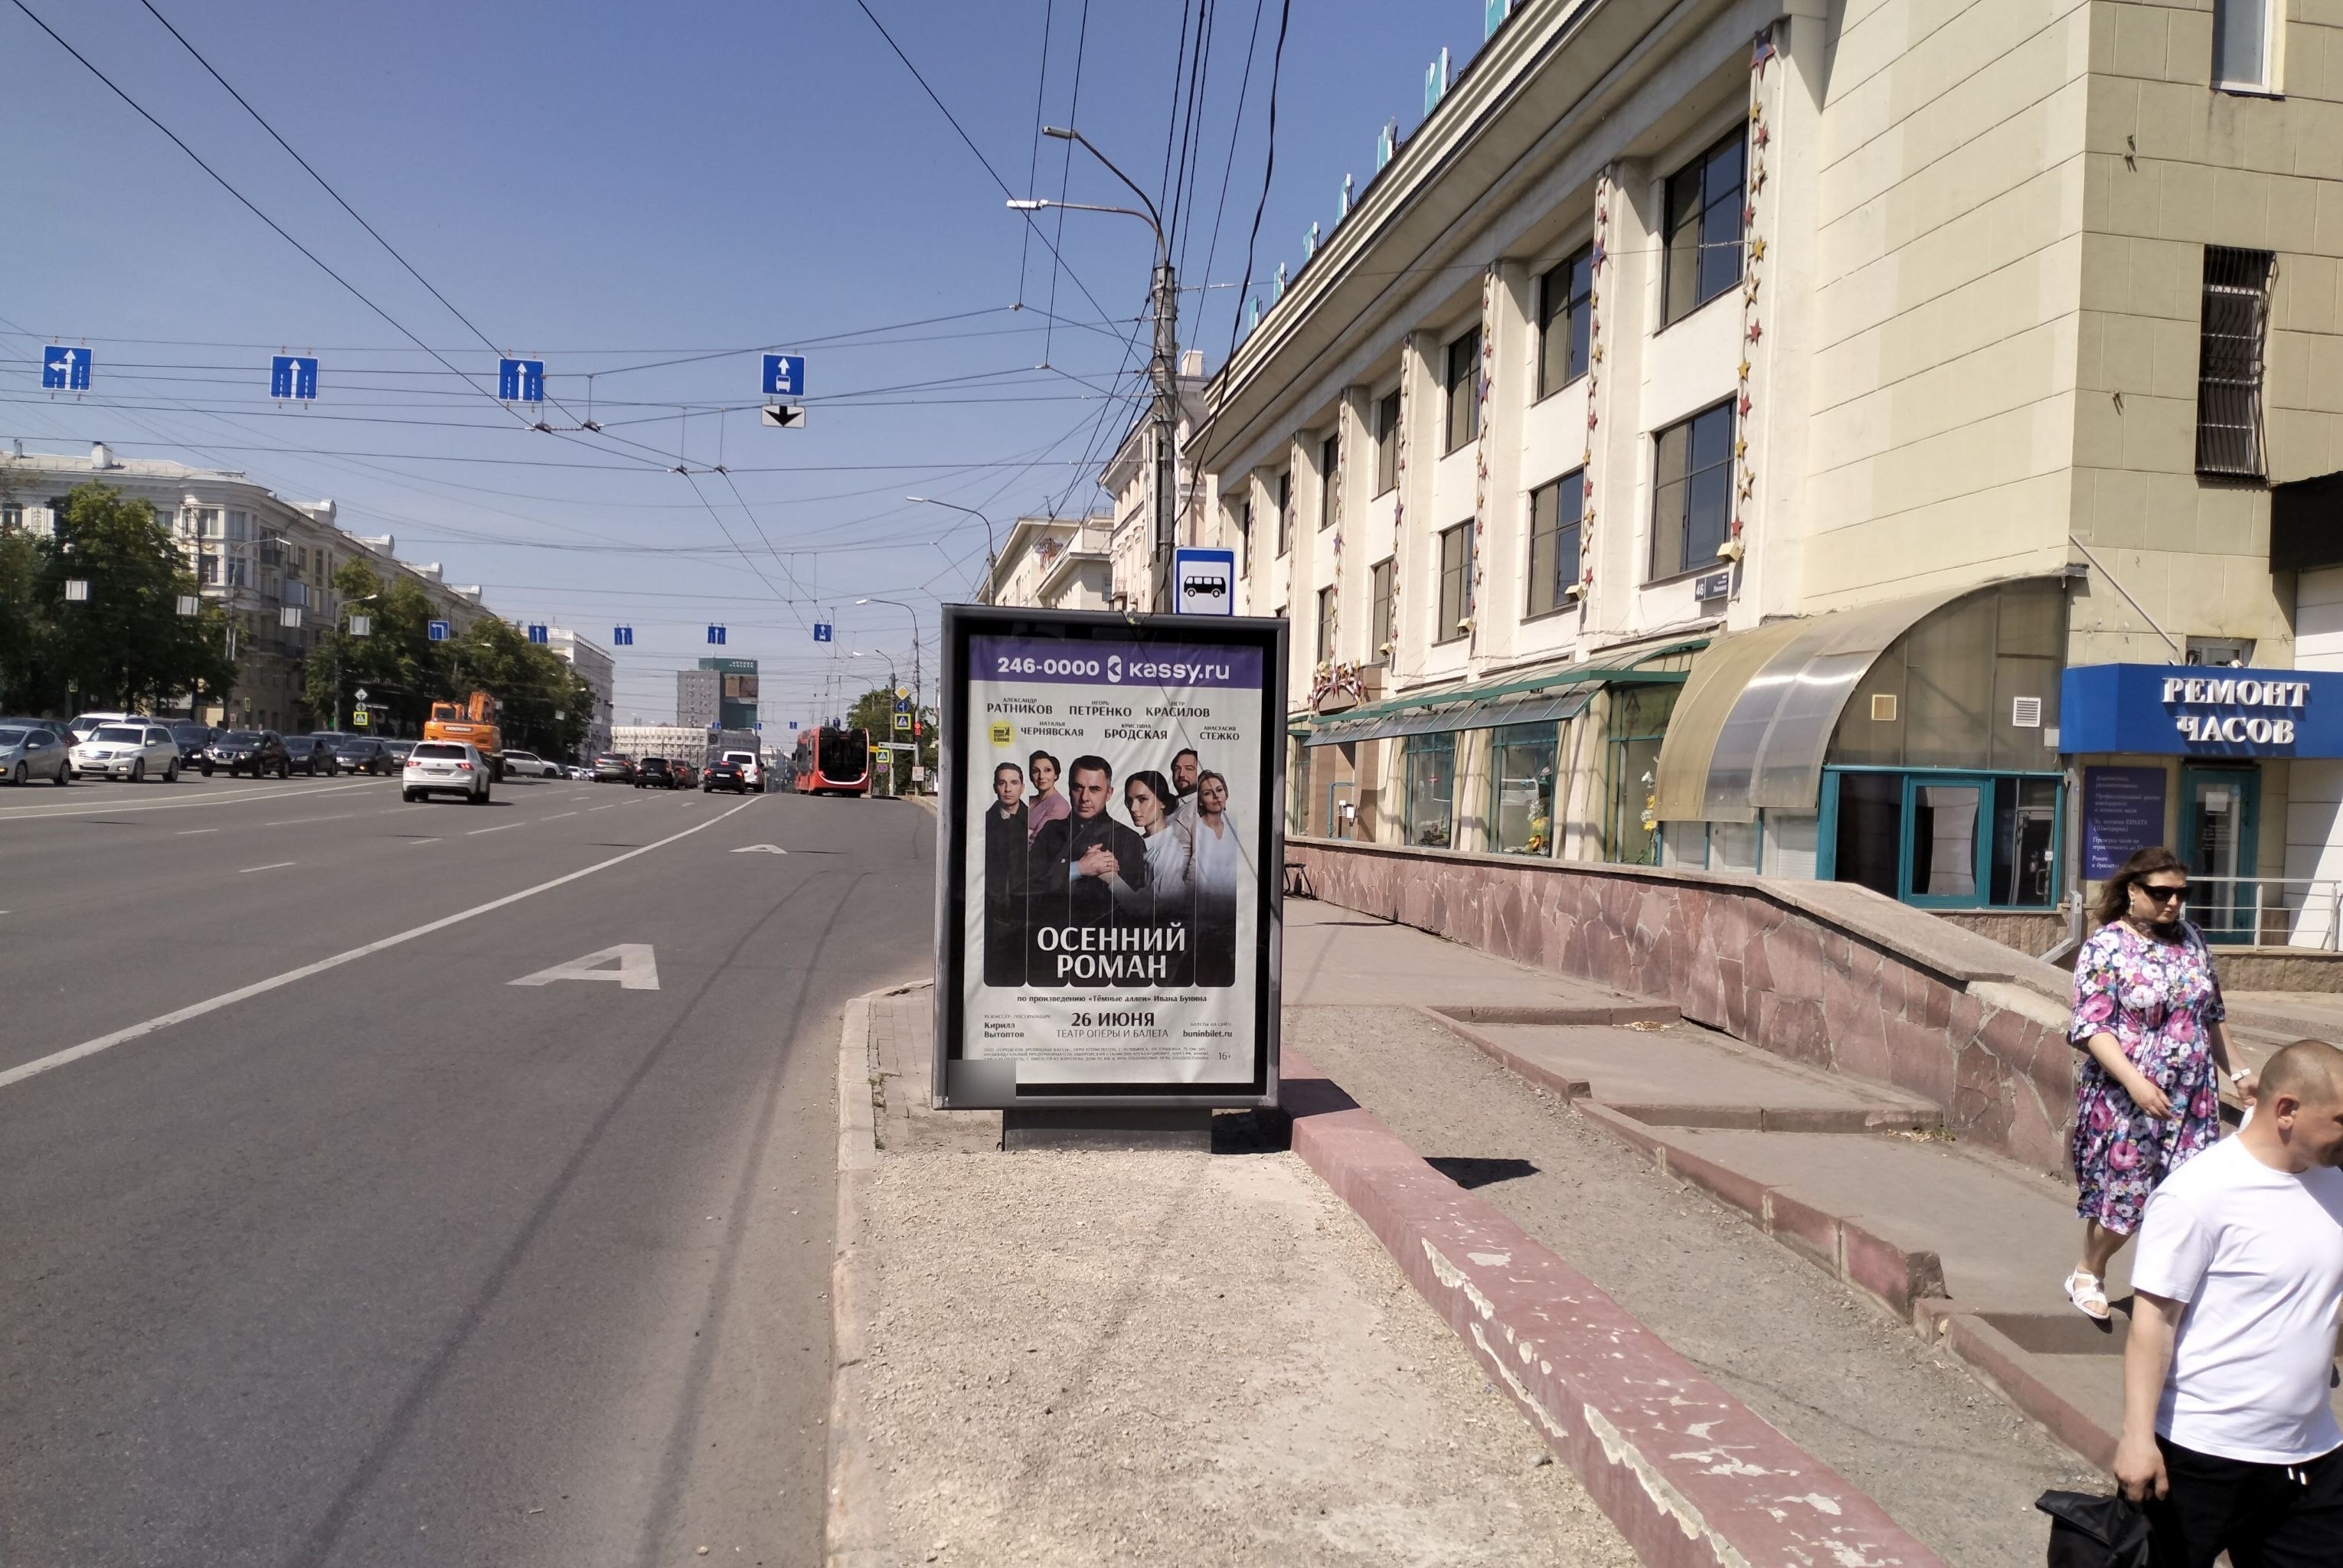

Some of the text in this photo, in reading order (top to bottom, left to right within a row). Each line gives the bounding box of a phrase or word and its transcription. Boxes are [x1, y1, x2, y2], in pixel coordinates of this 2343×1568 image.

[1695, 583, 1704, 596] 46
[997, 657, 1230, 684] 246-0000 kassy.ru
[2162, 678, 2310, 707] РЕМОНТ
[986, 703, 1053, 715] РАТНИКОВ
[1069, 705, 1132, 717] ПЕТРЕНКО
[1145, 706, 1211, 718] КРАСИЛОВ
[1020, 727, 1084, 737] ЧЕРНЯВСКАЯ
[1104, 728, 1168, 741] БРОДСКАЯ
[1199, 731, 1240, 741] СТЕЖКО
[2175, 716, 2295, 744] ЧАСОВ
[1037, 922, 1186, 952] ОСЕННИЙ
[1057, 954, 1167, 979] РОМАН
[1180, 995, 1207, 1004] Бунина
[1070, 1011, 1155, 1027] 26 ИЮНЯ
[984, 1022, 1016, 1031] Кирилл
[1057, 1029, 1168, 1038] ТЕАТР ОПЕРЫ И БАЛЕТА
[1182, 1030, 1233, 1038] buninbilet.ru
[1218, 1051, 1231, 1060] 16+
